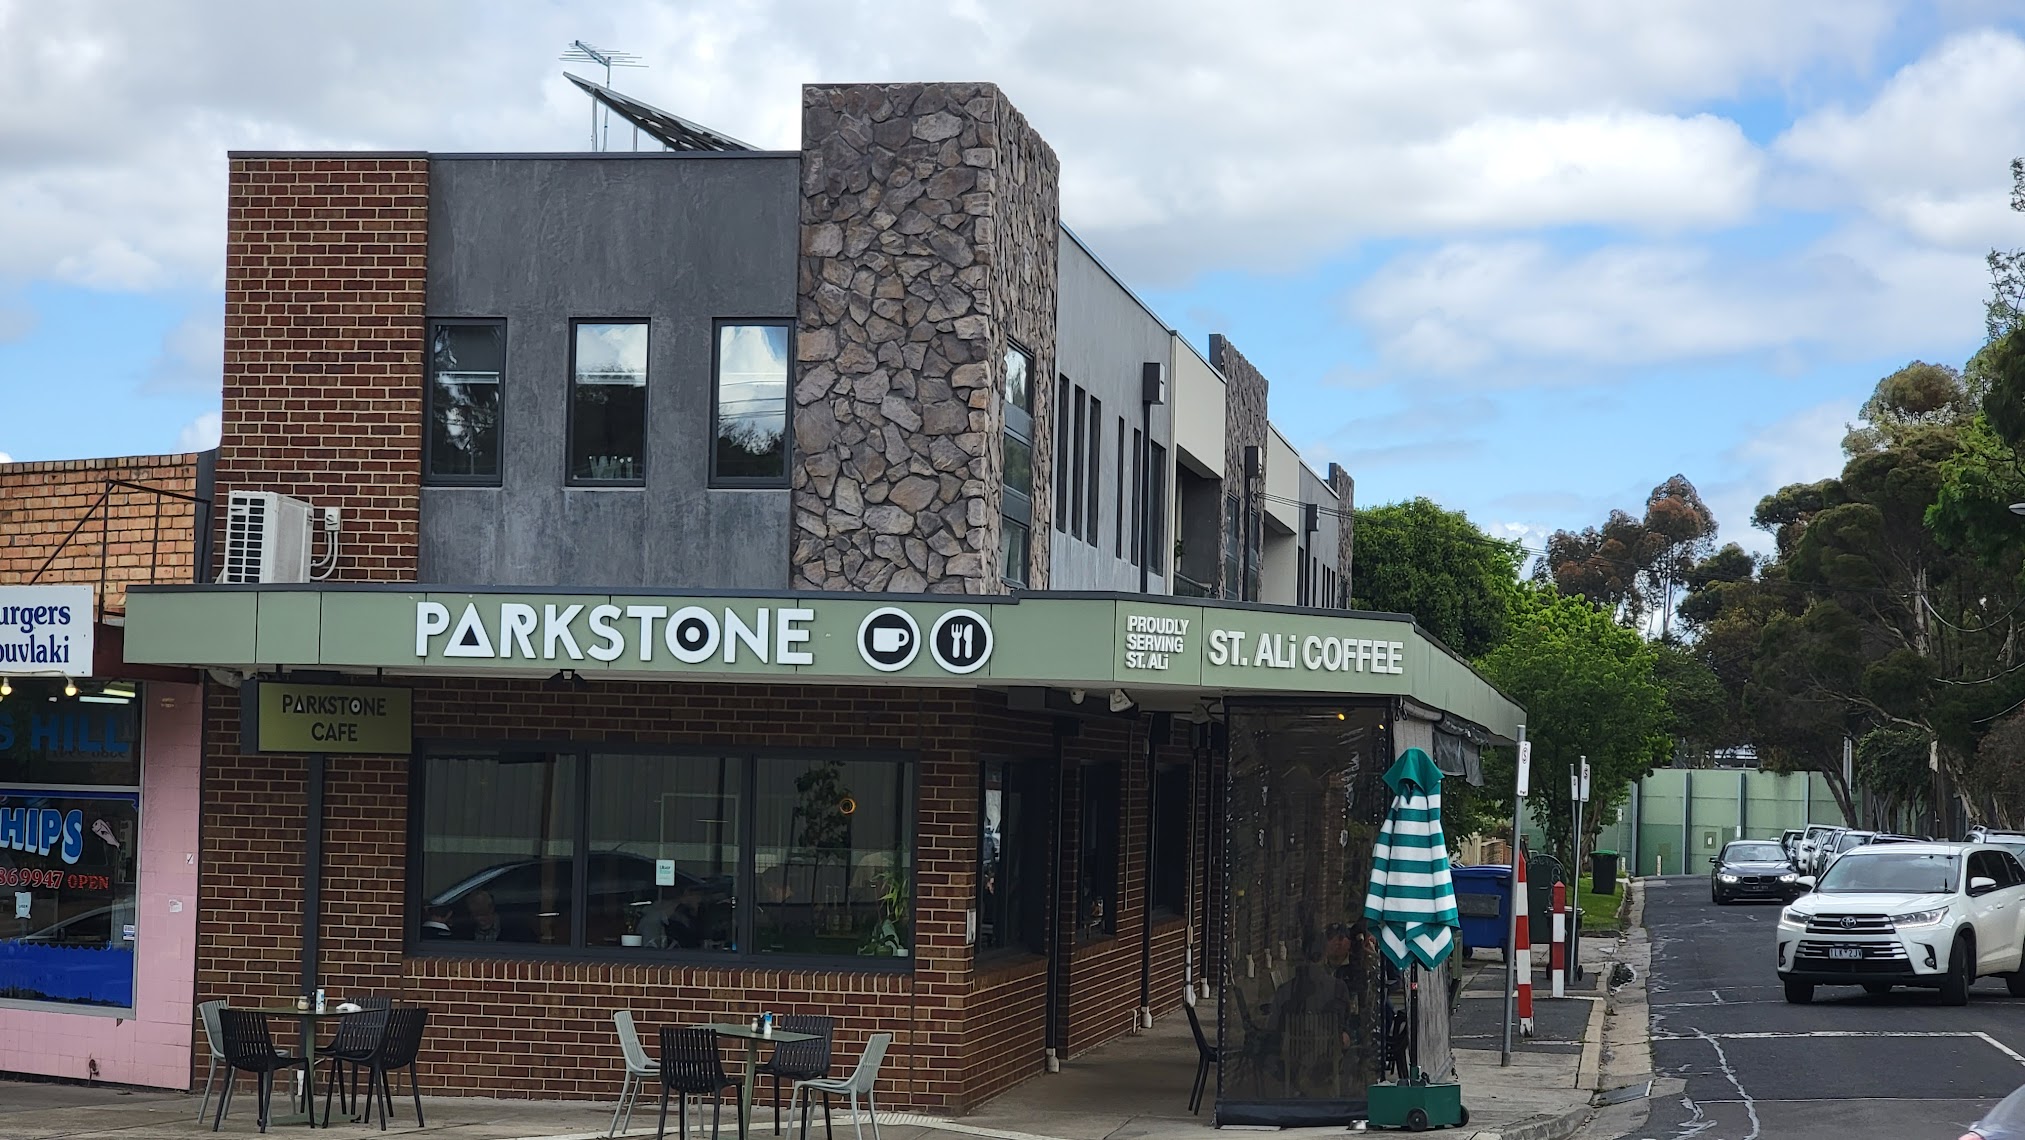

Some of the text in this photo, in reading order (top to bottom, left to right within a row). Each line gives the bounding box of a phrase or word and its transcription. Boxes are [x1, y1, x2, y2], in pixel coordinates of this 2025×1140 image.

[416, 602, 815, 665] PARKSTONE
[1126, 615, 1190, 636] PROUDLY
[1125, 633, 1184, 653] SERVING
[1207, 629, 1248, 667] ST.
[1301, 635, 1404, 675] COFFEE
[1125, 651, 1146, 669] ST.
[282, 694, 387, 716] PARKSTONE
[31, 713, 130, 753] HILL
[311, 722, 358, 742] CAFE
[67, 874, 110, 890] OPEN
